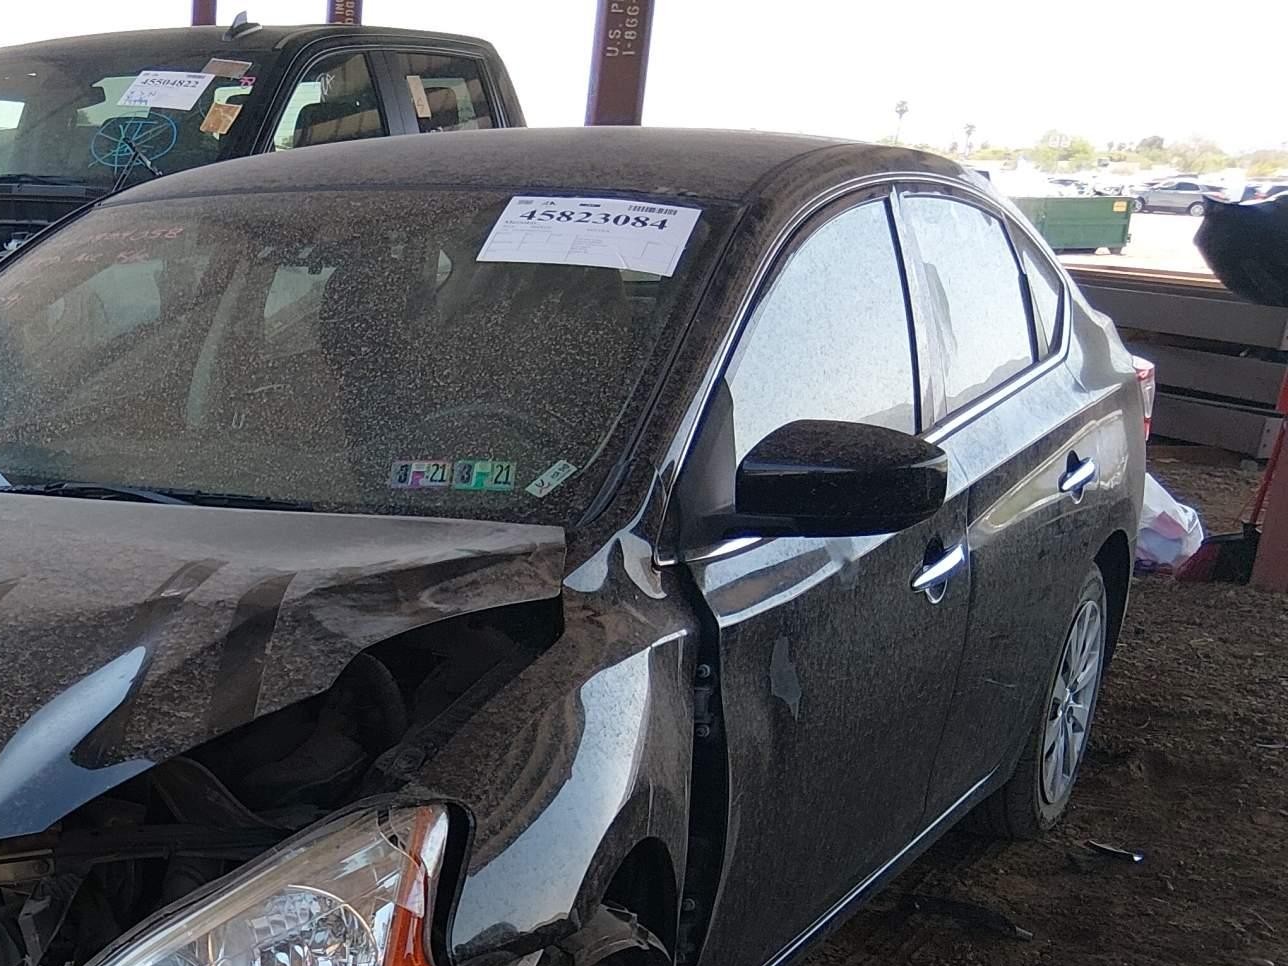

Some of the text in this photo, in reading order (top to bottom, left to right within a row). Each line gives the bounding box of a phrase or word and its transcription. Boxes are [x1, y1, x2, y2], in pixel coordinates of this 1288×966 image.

[519, 209, 669, 231] 45823084
[429, 463, 447, 482] 21
[493, 464, 511, 485] 21
